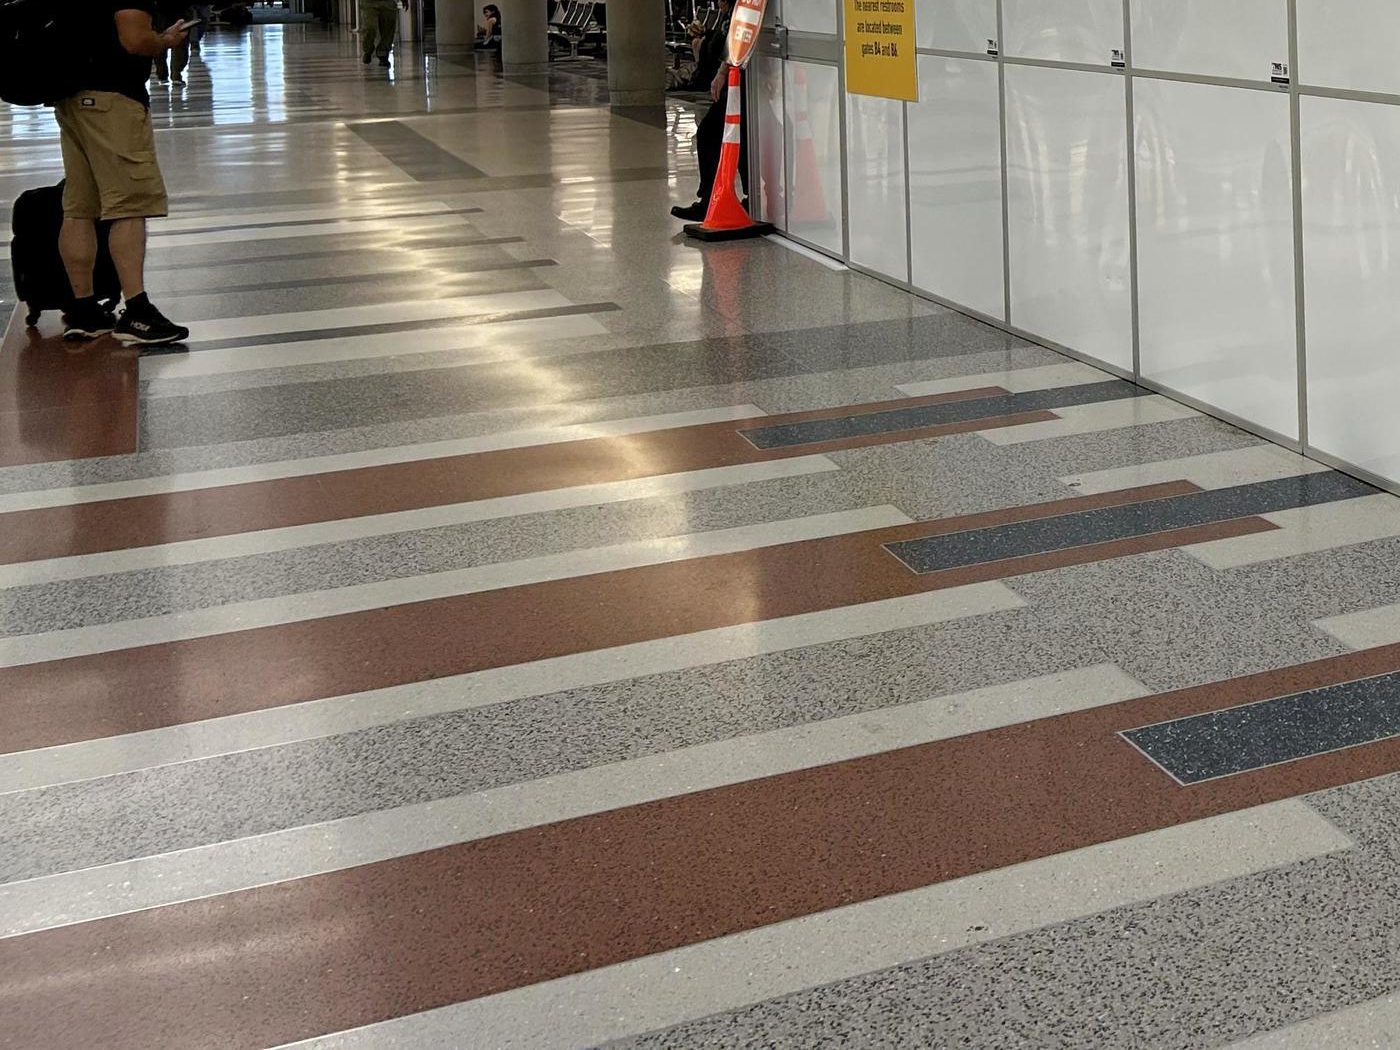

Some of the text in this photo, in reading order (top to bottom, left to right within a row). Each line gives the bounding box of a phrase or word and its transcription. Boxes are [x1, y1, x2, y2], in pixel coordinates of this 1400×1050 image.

[863, 0, 879, 12] nearest
[880, 0, 904, 13] restrooms
[865, 20, 882, 34] located
[882, 20, 902, 35] between
[862, 42, 874, 57] gates
[882, 43, 890, 56] and
